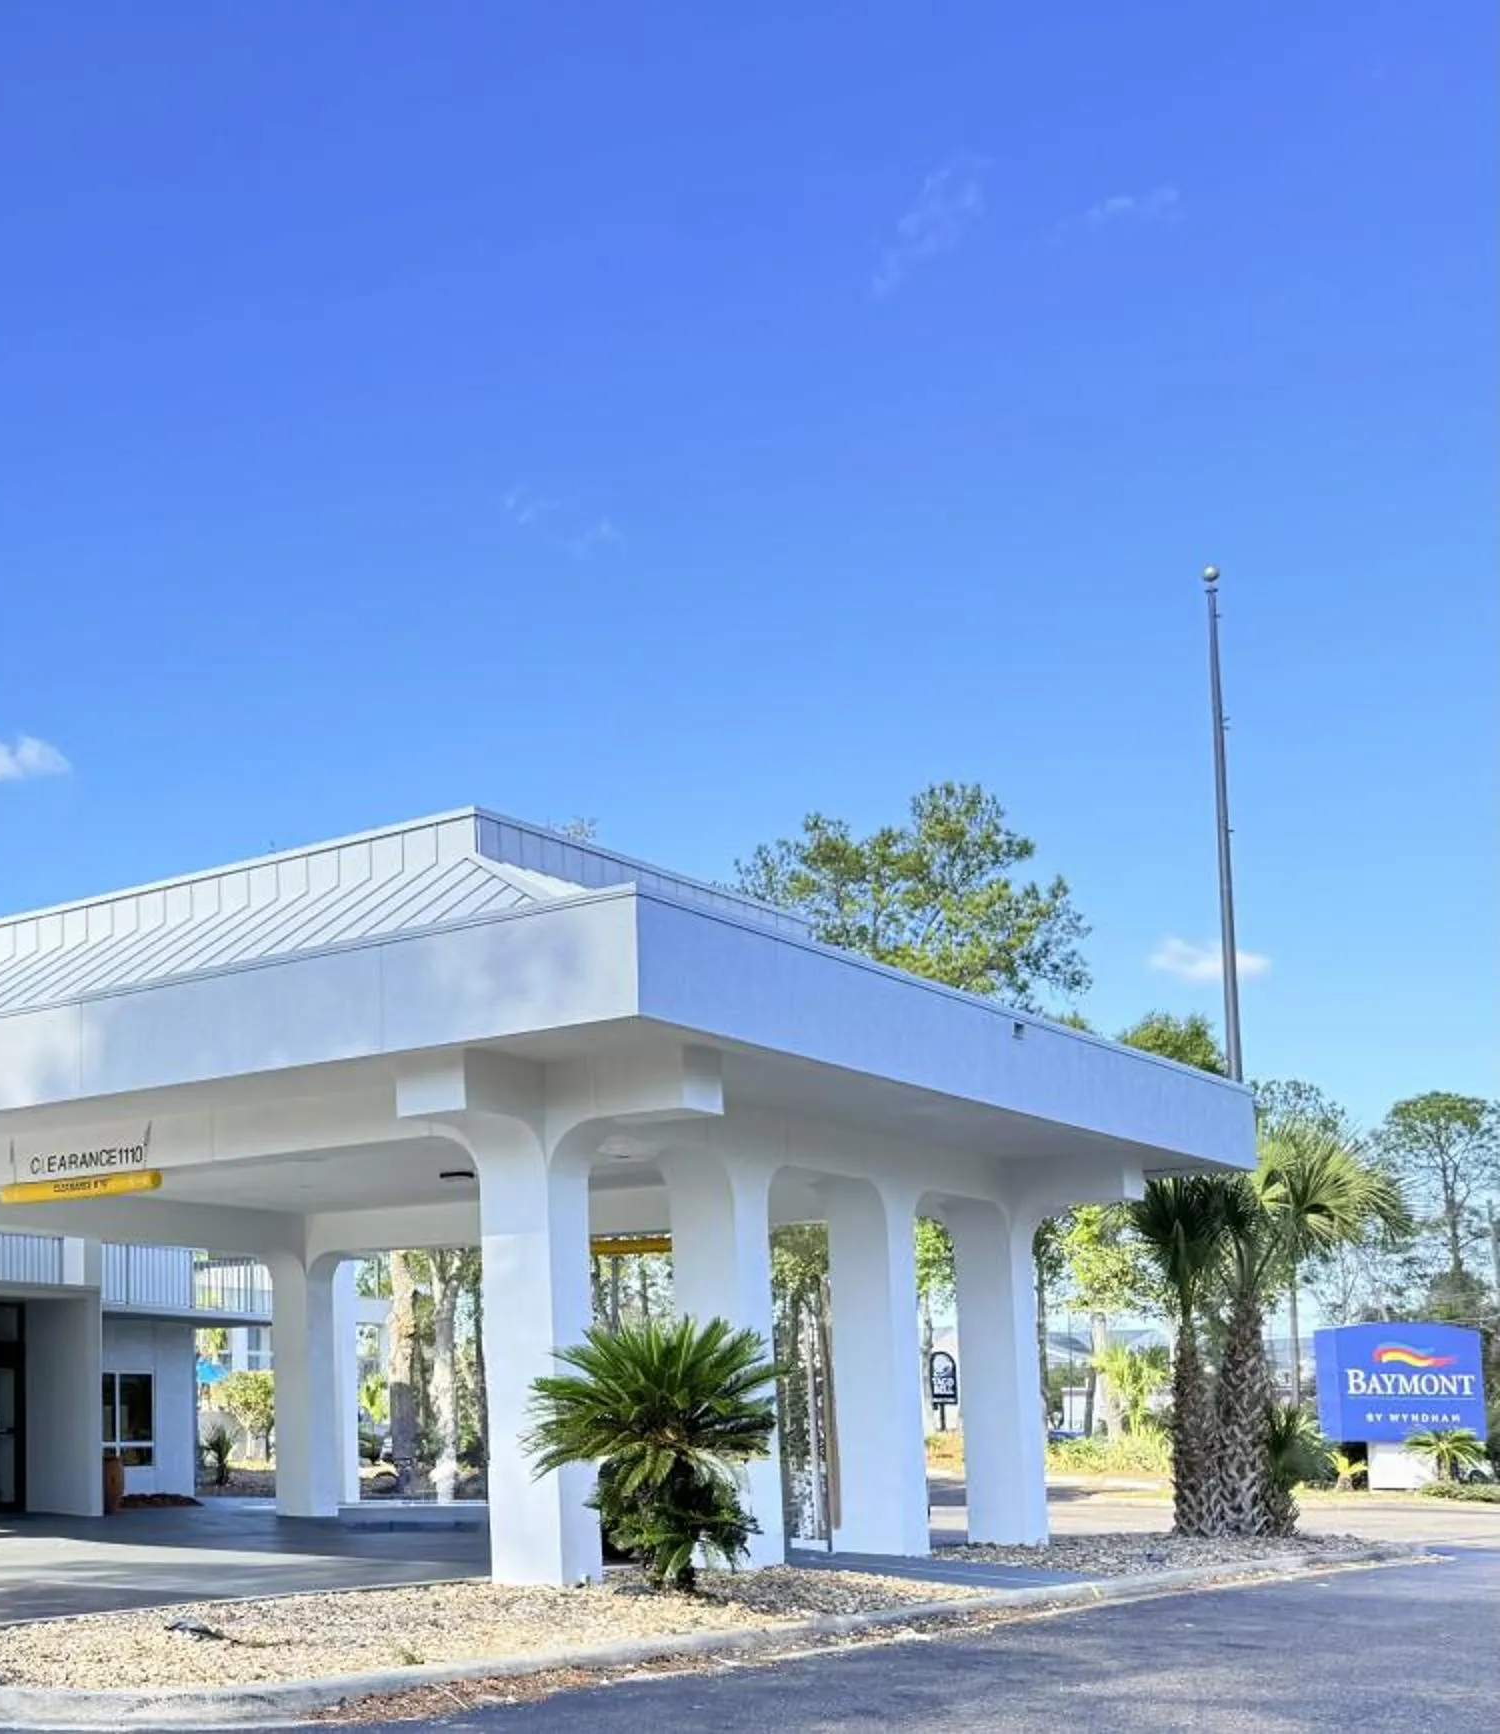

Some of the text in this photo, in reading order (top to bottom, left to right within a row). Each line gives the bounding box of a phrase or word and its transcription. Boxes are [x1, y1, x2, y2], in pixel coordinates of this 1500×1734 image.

[1346, 1369, 1475, 1395] BAYMONT
[1365, 1412, 1461, 1423] BY WYNDHAM
